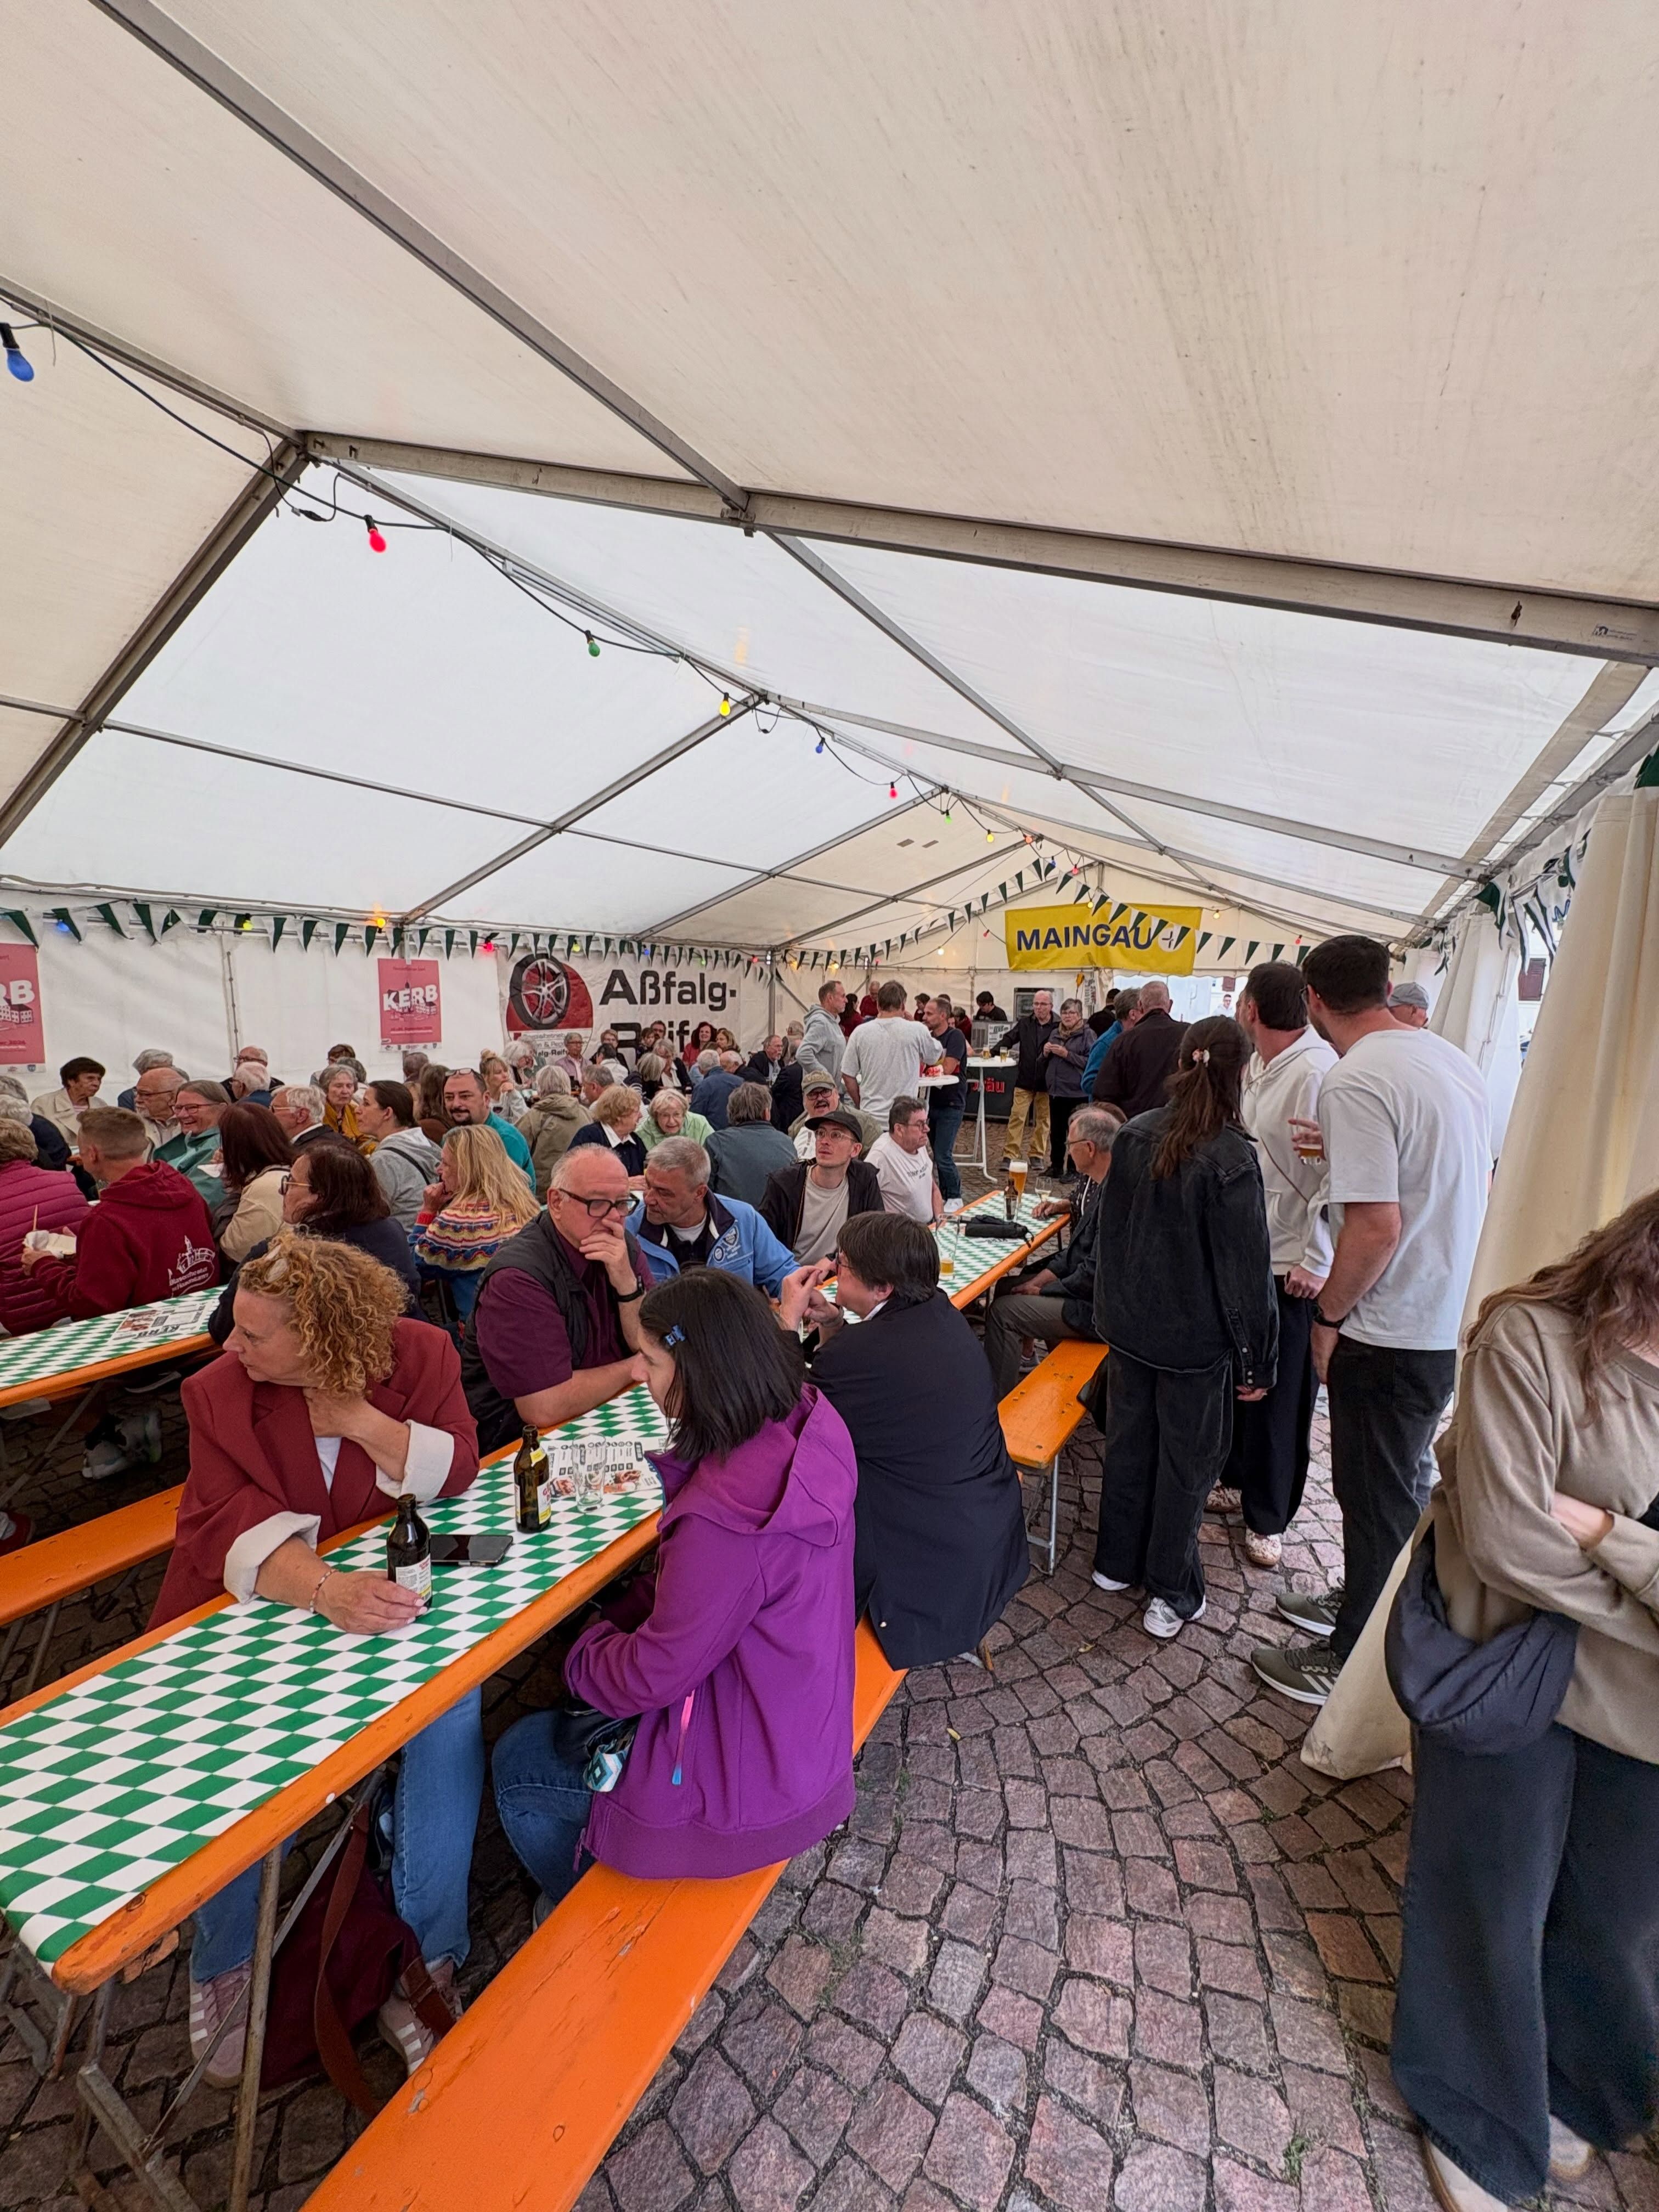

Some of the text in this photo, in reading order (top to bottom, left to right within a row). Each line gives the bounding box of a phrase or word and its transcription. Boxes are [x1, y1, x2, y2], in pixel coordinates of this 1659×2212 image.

[1017, 924, 1152, 951] MAINGAU
[383, 985, 438, 1011] KERB
[599, 969, 736, 1011] Aßfalg-
